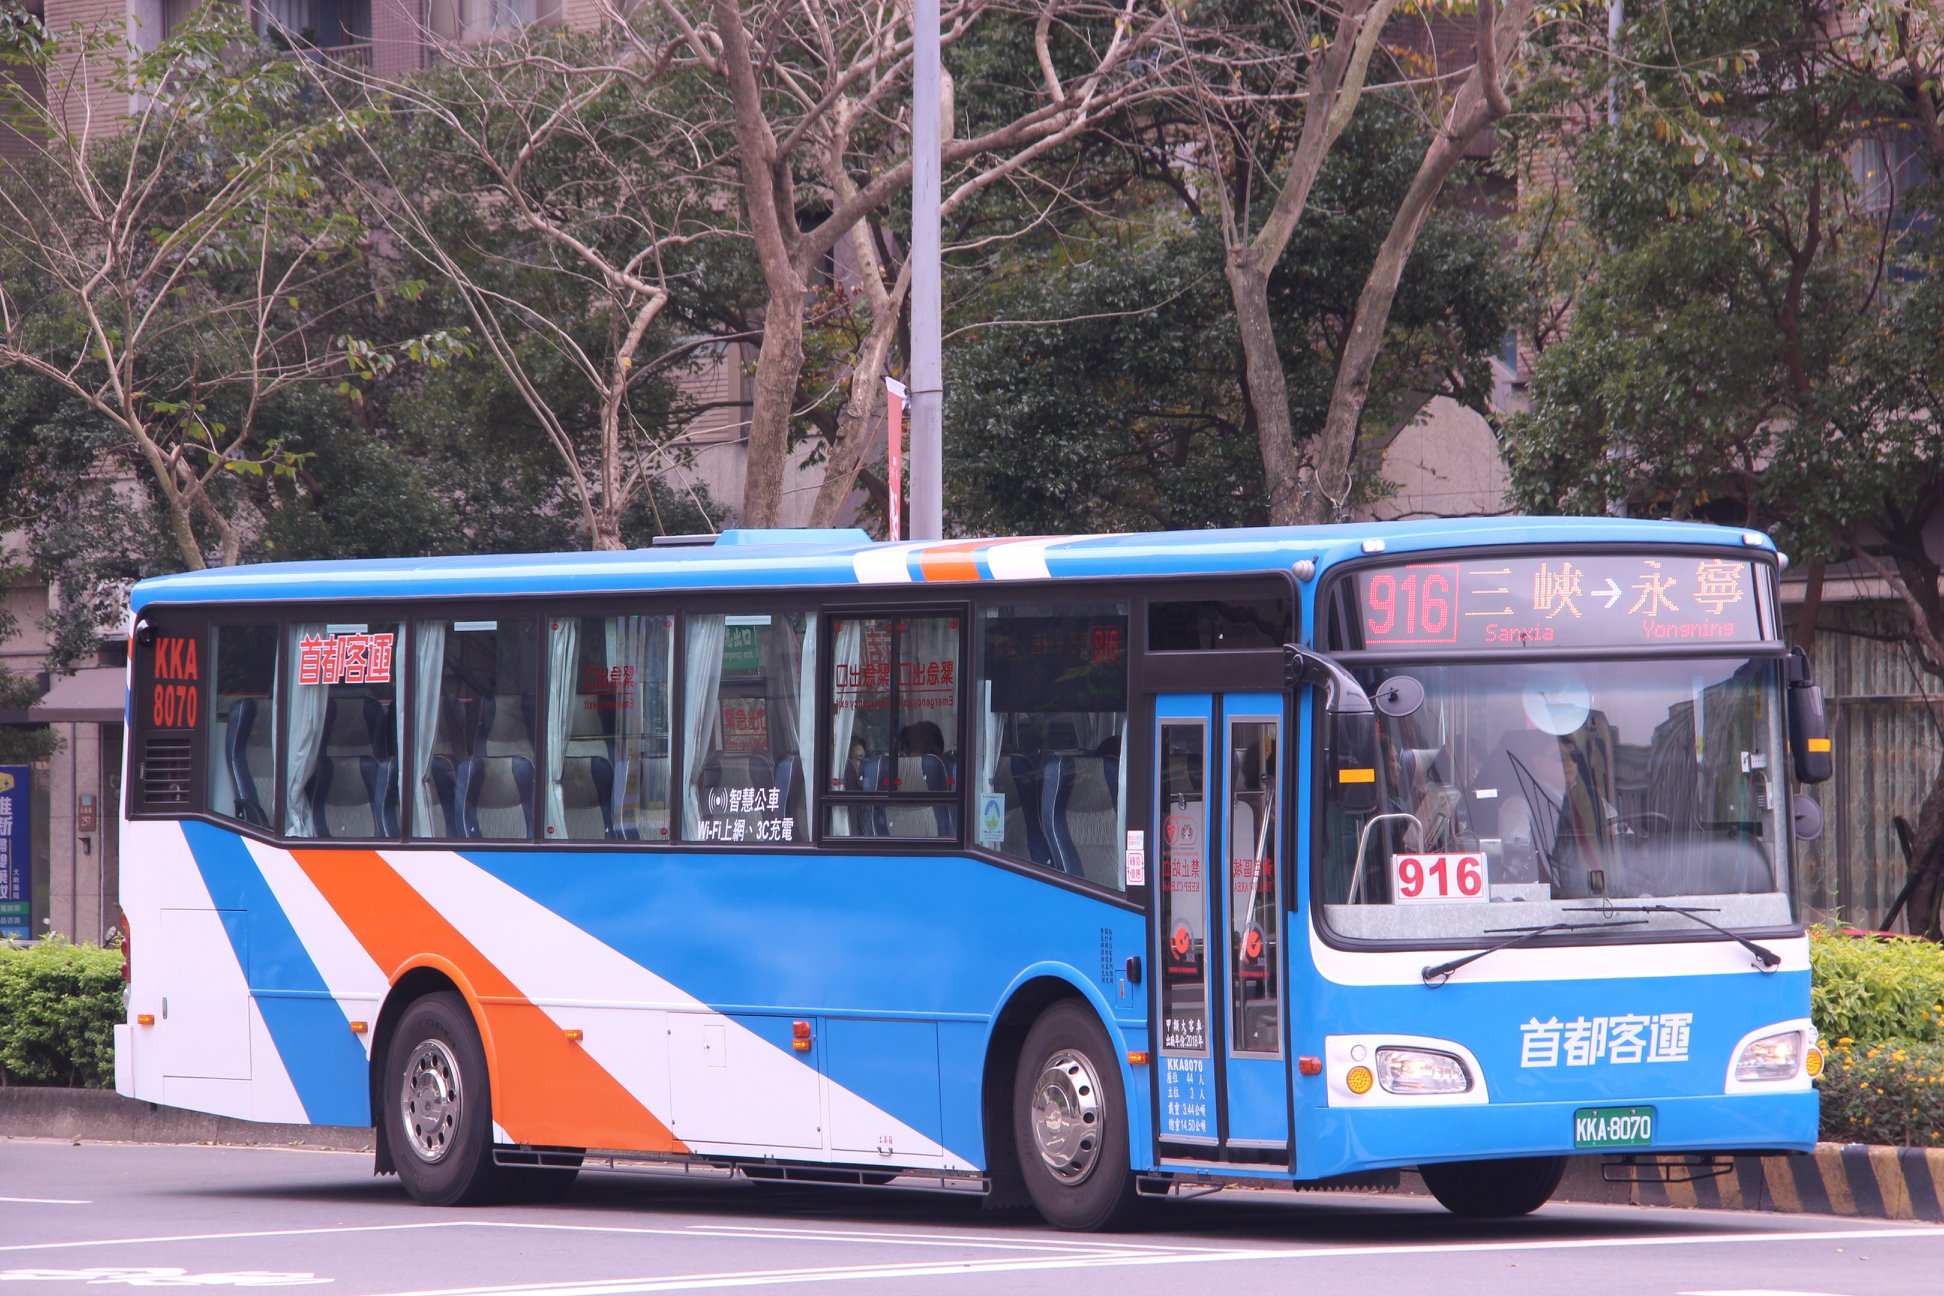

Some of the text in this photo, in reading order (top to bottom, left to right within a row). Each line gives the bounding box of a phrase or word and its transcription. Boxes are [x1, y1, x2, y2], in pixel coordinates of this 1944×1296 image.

[1367, 573, 1450, 635] 916
[1465, 558, 1745, 619] 三峽 永寧
[1485, 619, 1735, 643] Sanxia Yongning
[154, 637, 198, 681] KKA
[298, 632, 395, 685] 首都客運
[153, 685, 198, 729] 8070
[729, 786, 780, 813] 智慧公車
[1398, 856, 1482, 898] 916
[1520, 1012, 1693, 1068] 首都客運
[1167, 1058, 1203, 1072] KKA8070
[1576, 1115, 1651, 1142] KKA-8070
